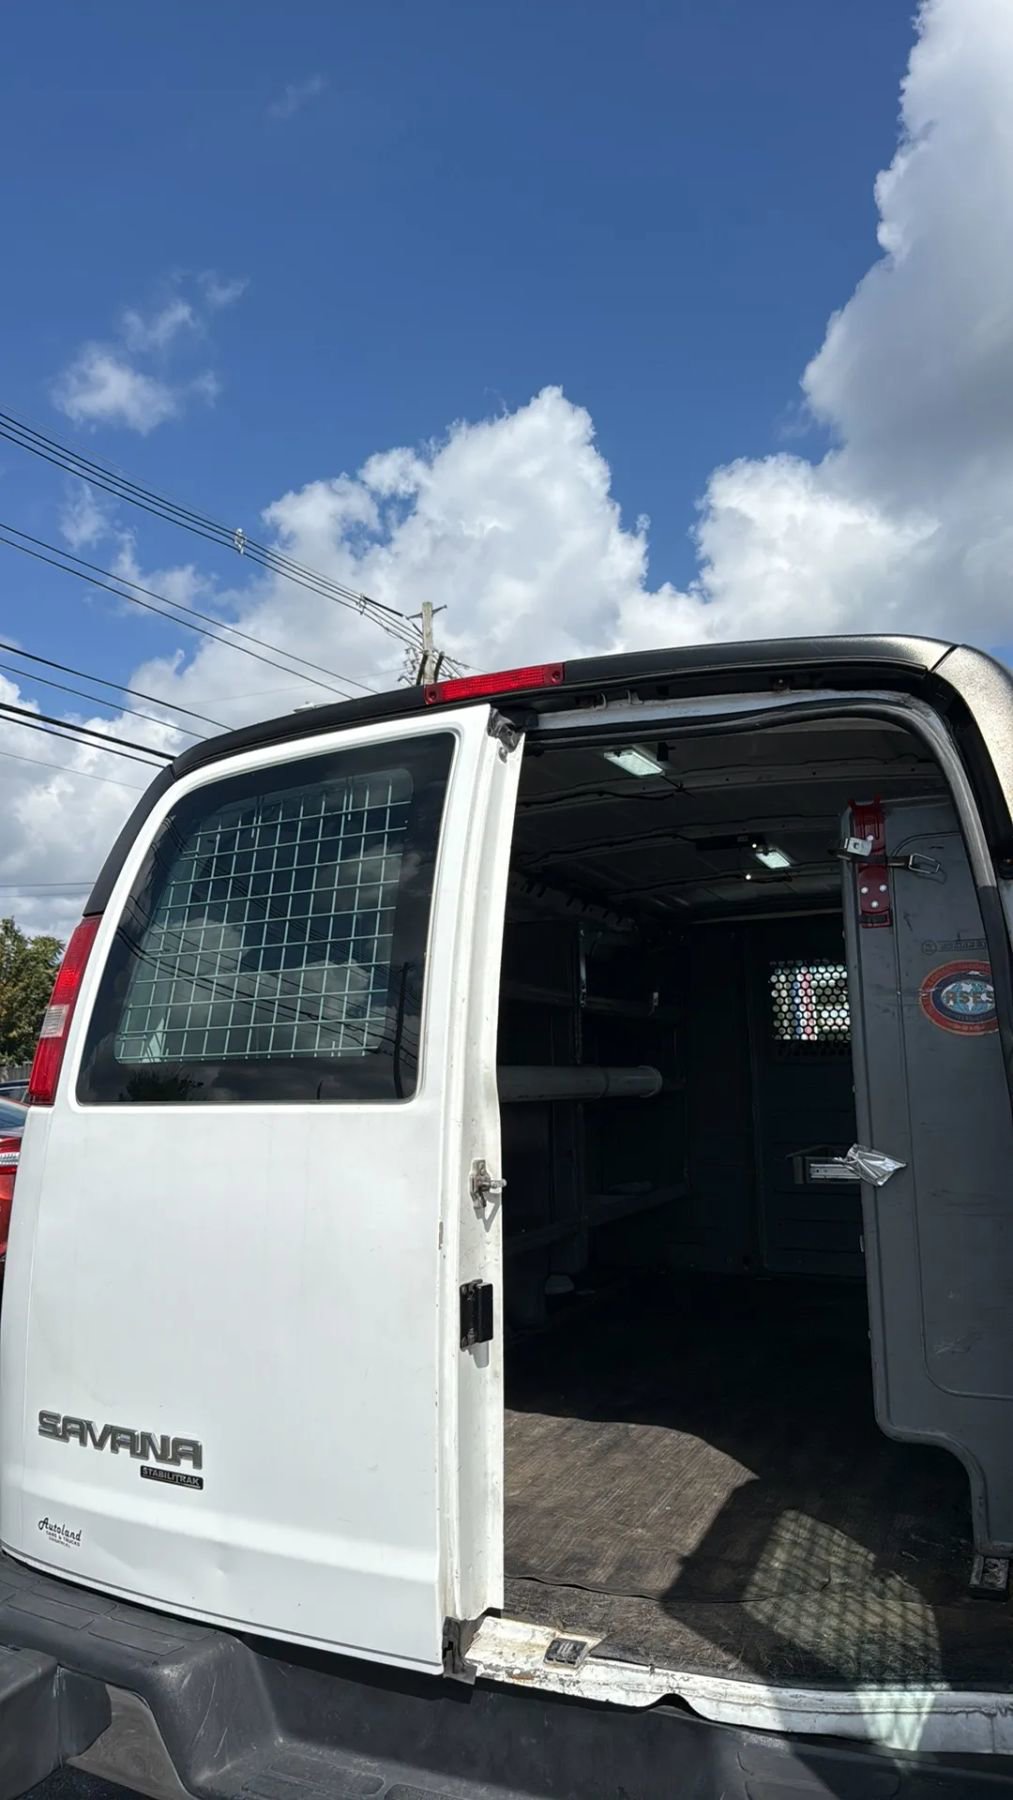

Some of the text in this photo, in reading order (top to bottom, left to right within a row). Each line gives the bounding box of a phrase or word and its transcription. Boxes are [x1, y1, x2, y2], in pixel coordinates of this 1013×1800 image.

[38, 1409, 203, 1470] SAVANA
[142, 1466, 200, 1486] STABILITRAK
[38, 1516, 82, 1542] Autoland
